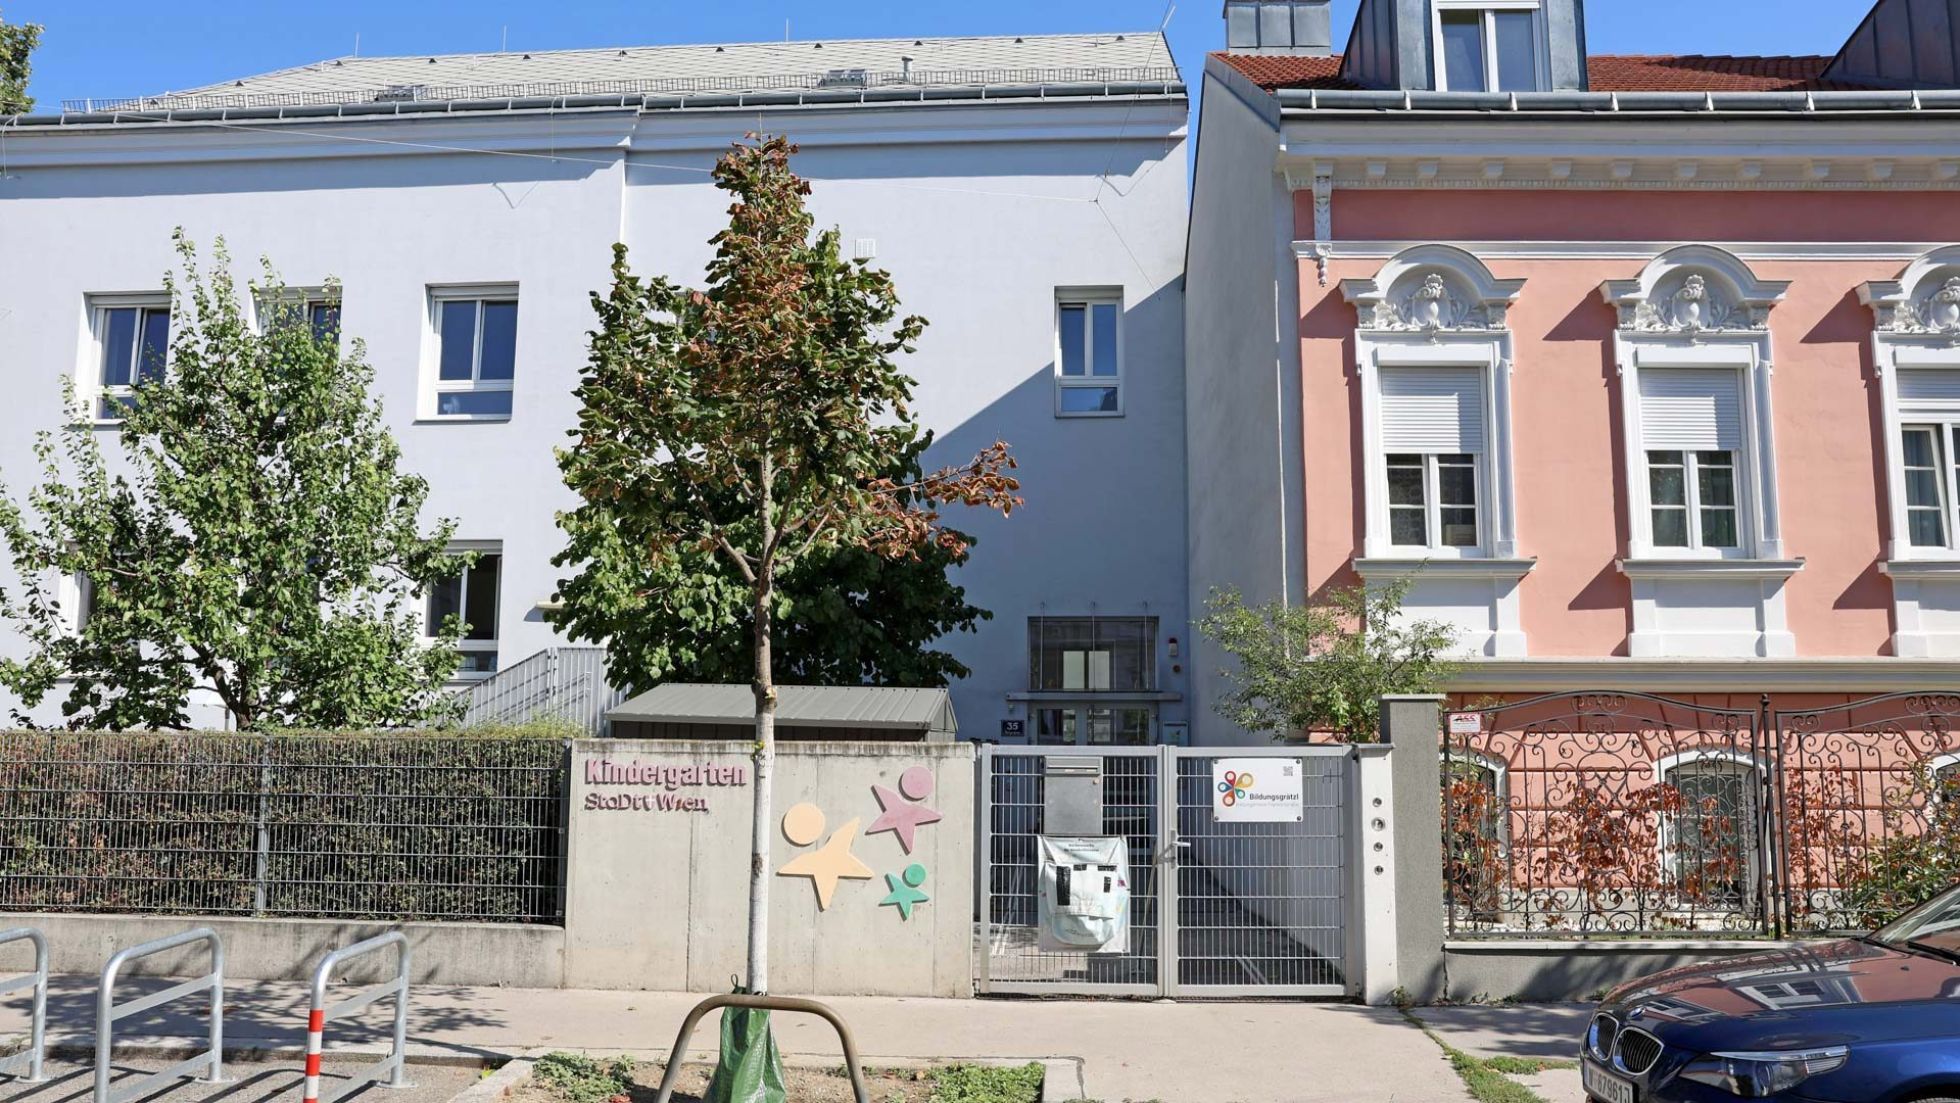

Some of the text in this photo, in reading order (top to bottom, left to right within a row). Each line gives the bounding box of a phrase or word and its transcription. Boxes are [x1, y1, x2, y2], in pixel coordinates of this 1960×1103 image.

[586, 759, 747, 790] Kindergarten
[656, 793, 708, 812] Wien
[1249, 793, 1299, 802] Bildungsgrätzl
